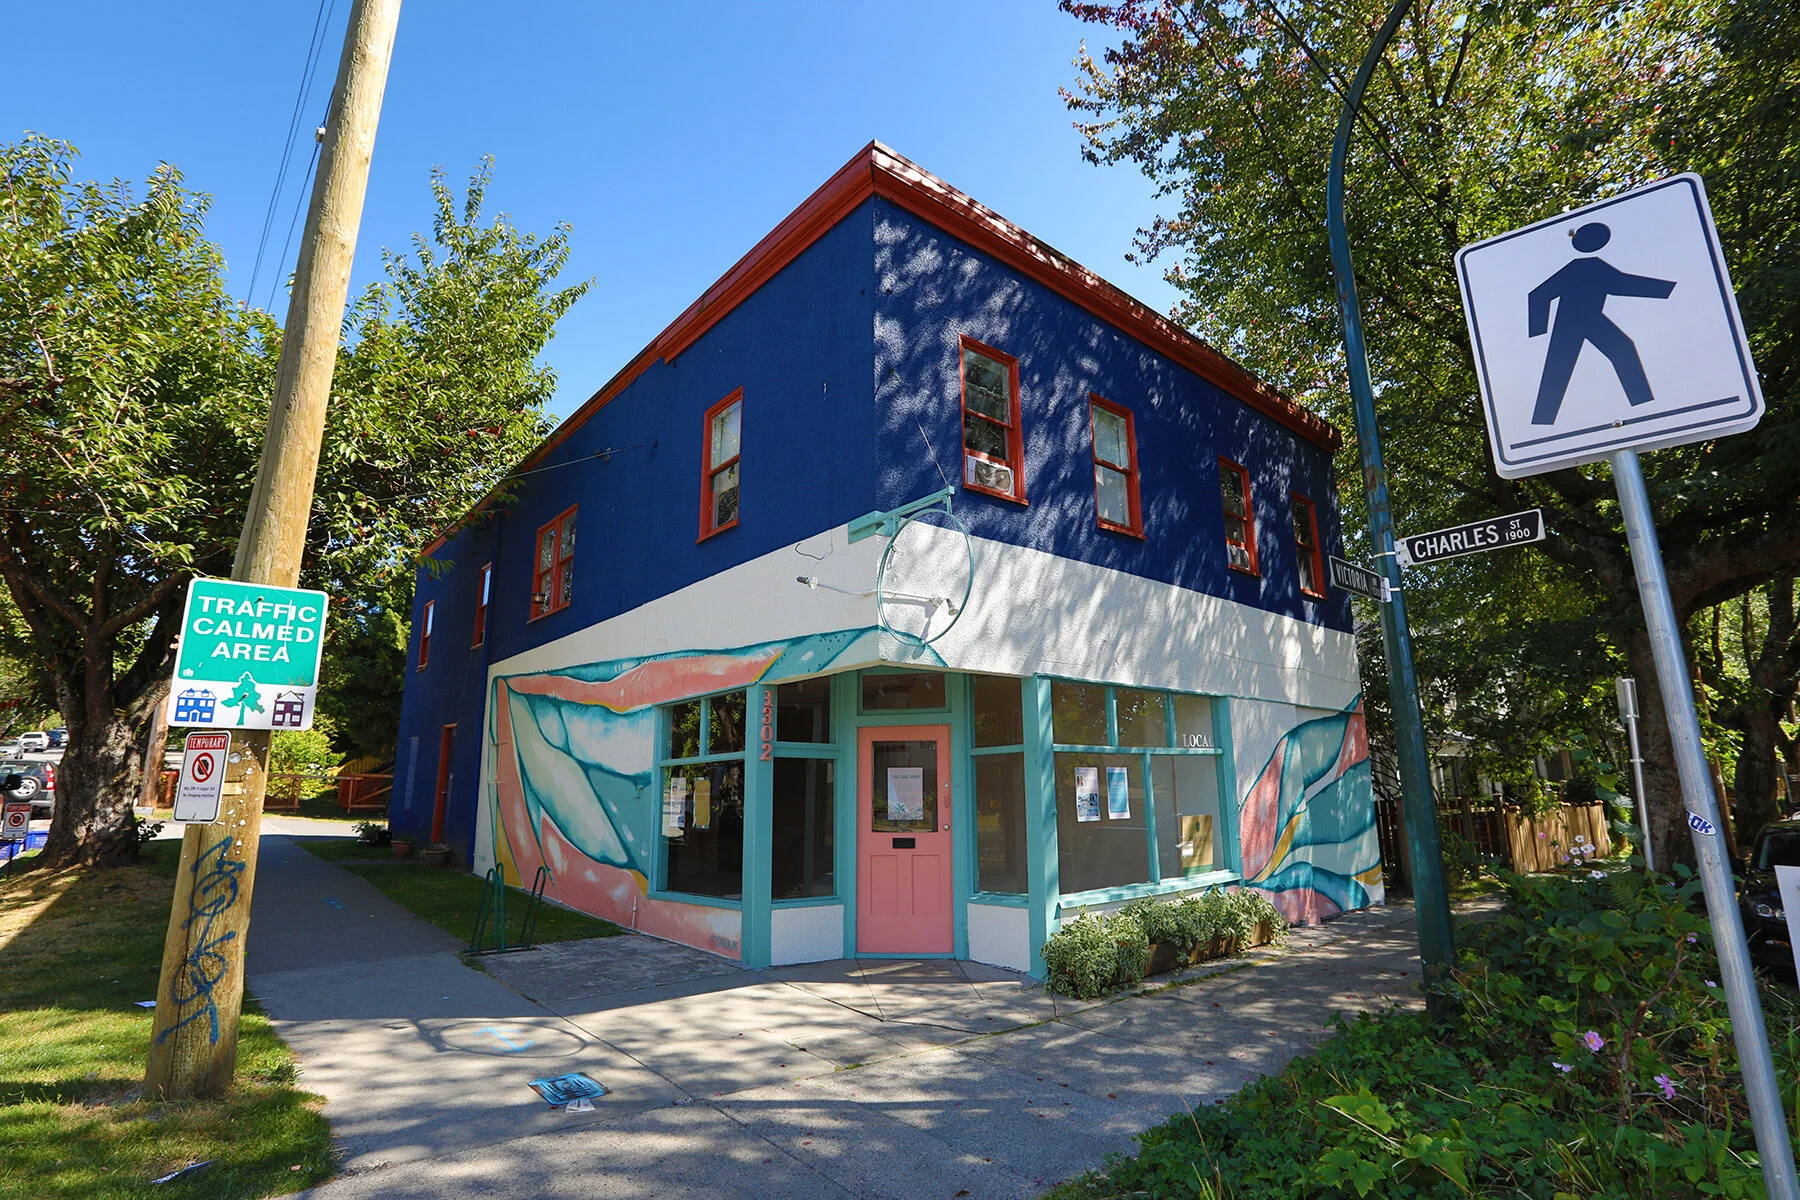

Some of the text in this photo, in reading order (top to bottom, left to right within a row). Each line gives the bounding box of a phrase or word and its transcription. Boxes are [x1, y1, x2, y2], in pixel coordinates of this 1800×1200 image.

[1414, 518, 1521, 559] CHARLES ST
[1505, 527, 1531, 541] 1900
[1335, 563, 1369, 592] VICTORIA
[197, 595, 317, 623] TRAFFIC
[192, 617, 315, 643] CALMED
[210, 641, 291, 663] AREA
[759, 689, 774, 761] 1302
[189, 736, 226, 749] TEMPORARY
